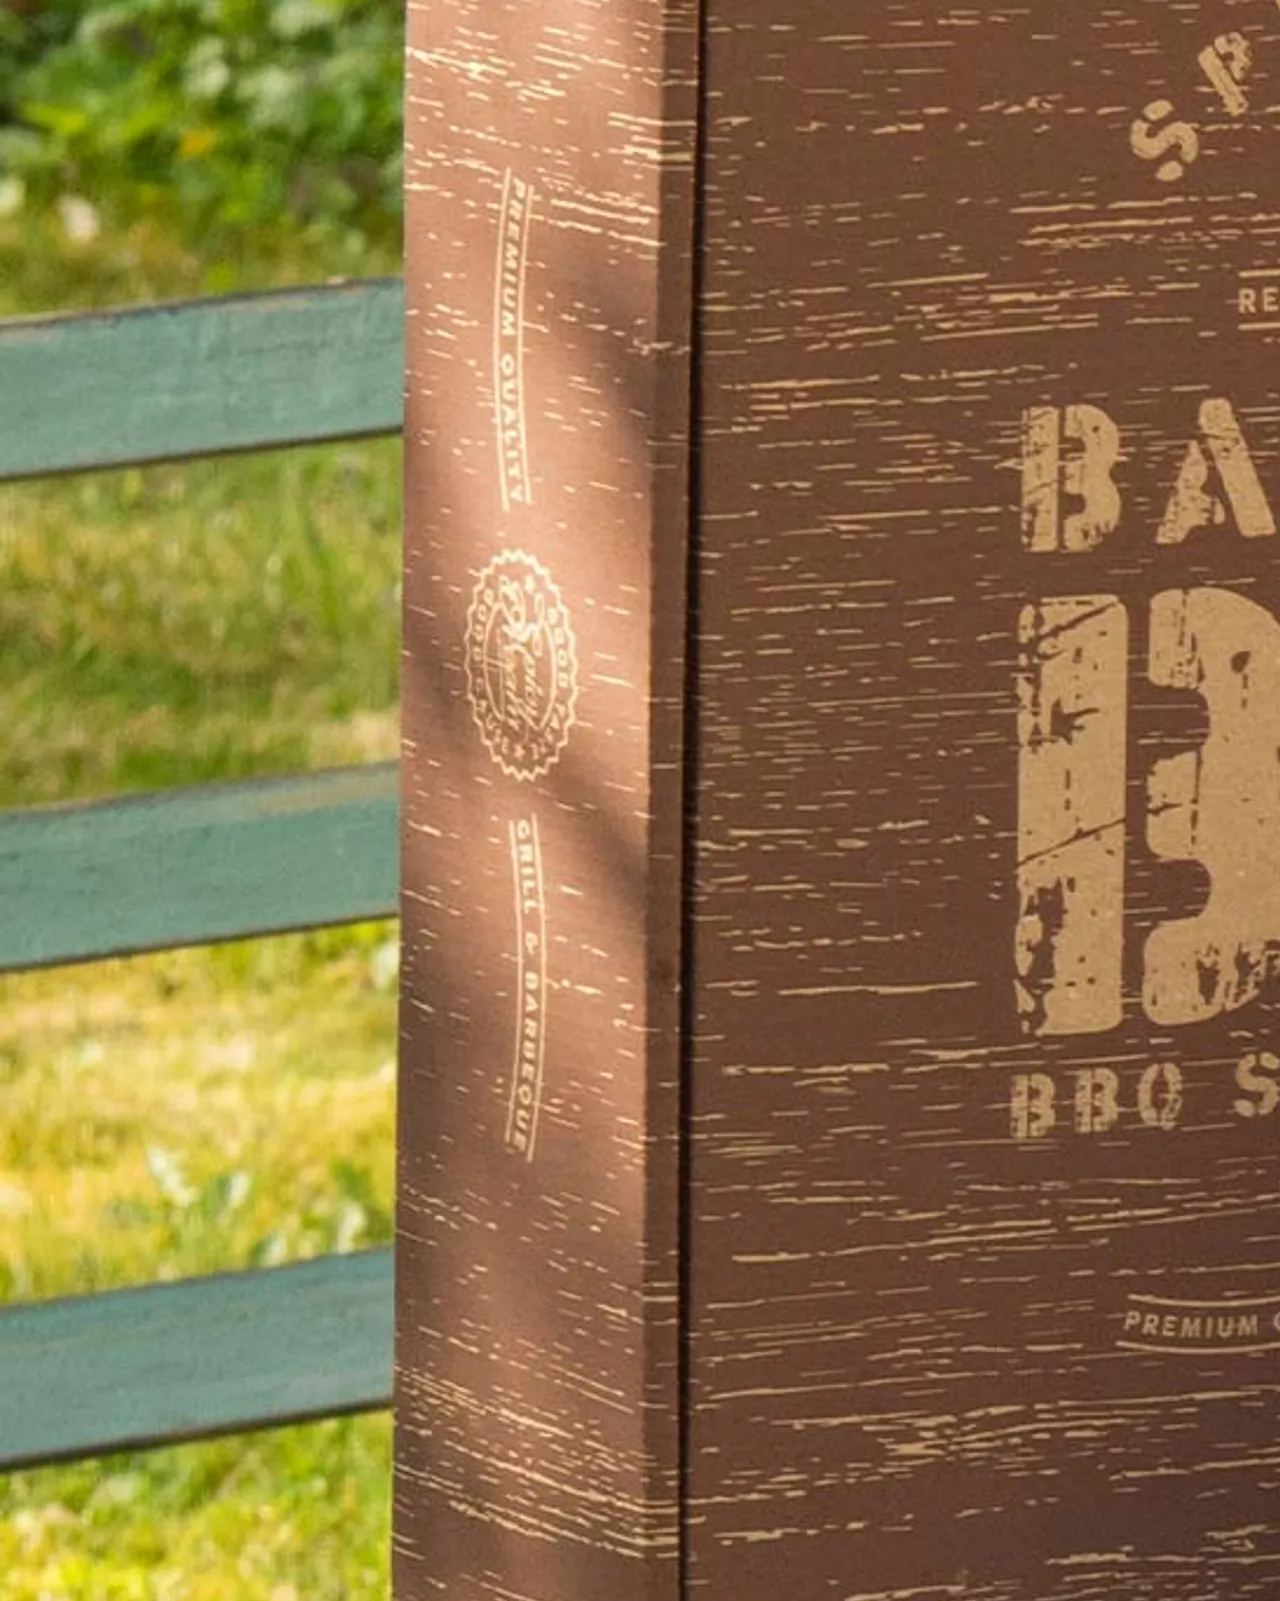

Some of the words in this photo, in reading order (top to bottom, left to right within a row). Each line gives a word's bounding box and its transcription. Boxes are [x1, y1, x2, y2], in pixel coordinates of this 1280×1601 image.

[501, 177, 525, 336] PREMIUM
[501, 353, 524, 503] QUALITY
[517, 818, 538, 915] GRILL
[1009, 1061, 1183, 1139] BBQ
[1123, 1310, 1259, 1338] PREMIUM
